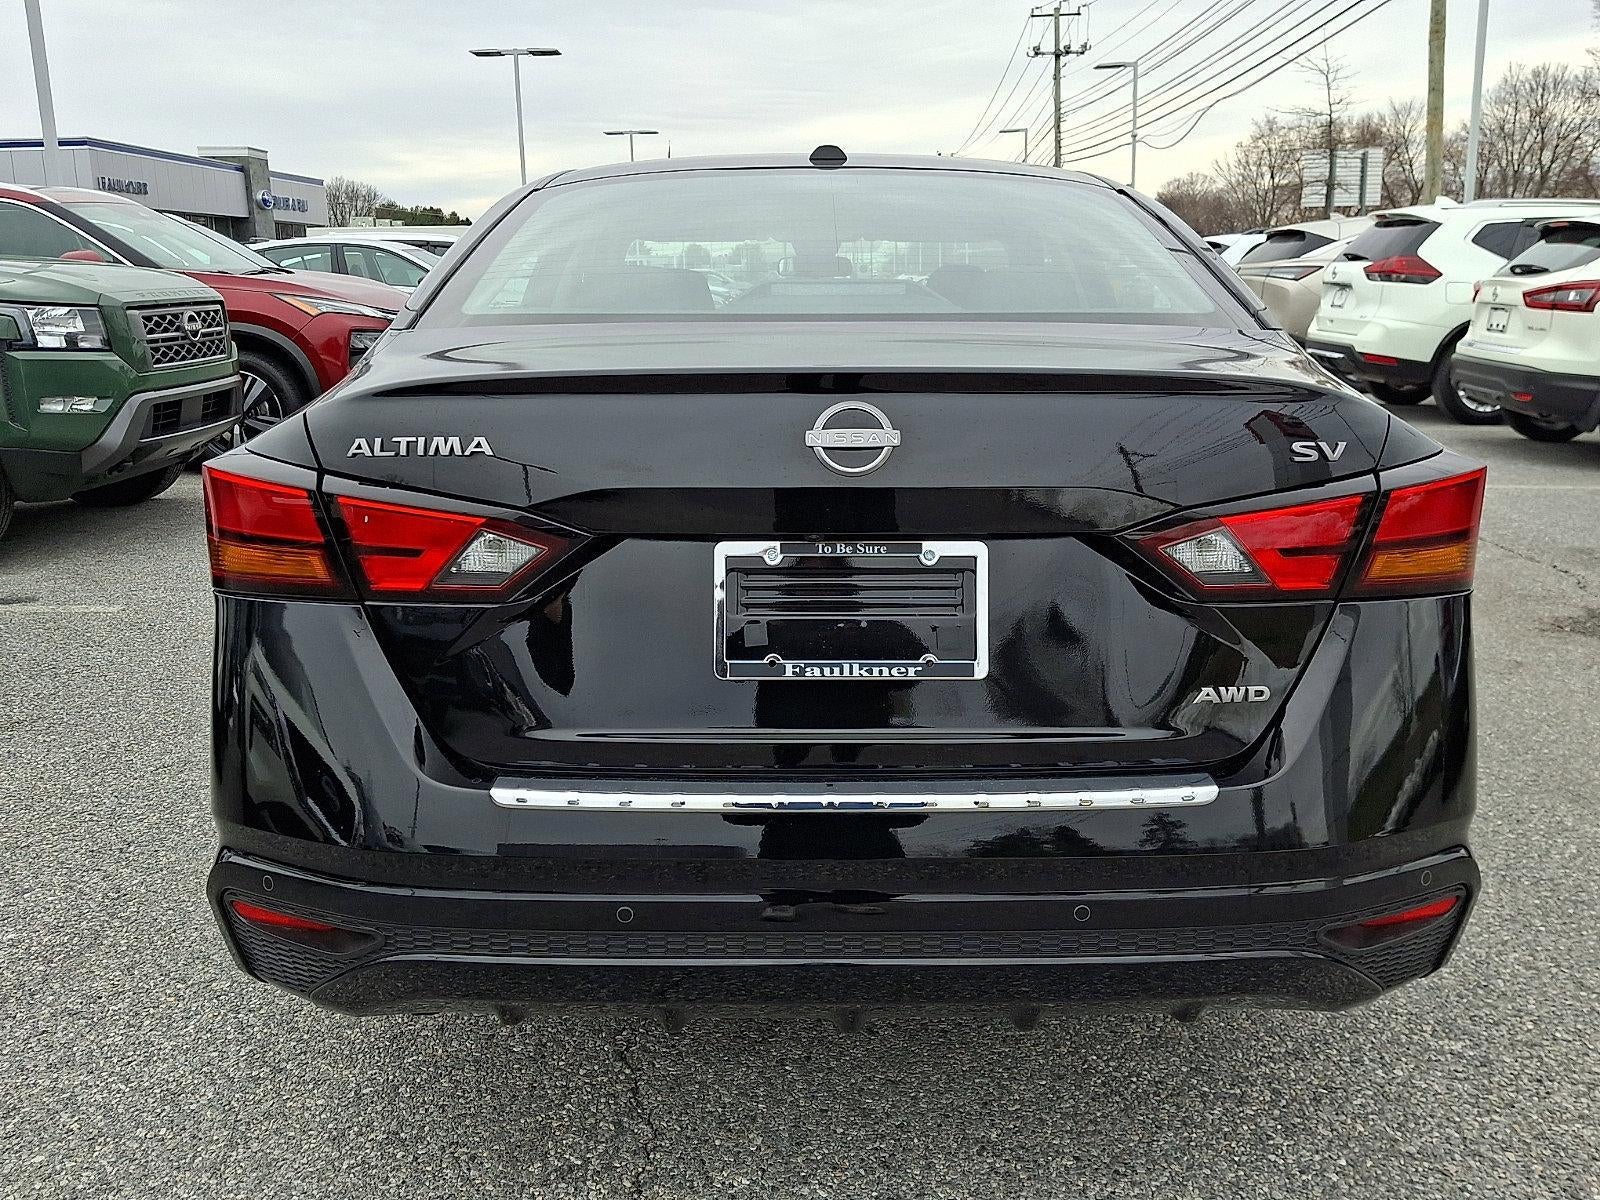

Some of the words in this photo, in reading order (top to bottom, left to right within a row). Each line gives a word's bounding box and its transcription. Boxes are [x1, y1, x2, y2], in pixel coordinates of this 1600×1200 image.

[807, 432, 898, 444] NISSAN
[346, 436, 495, 457] ALTIMA
[1290, 441, 1348, 462] SV
[815, 543, 832, 554] To
[836, 543, 853, 554] Be
[856, 543, 888, 554] Sure
[782, 663, 923, 677] Faulkner
[1192, 685, 1271, 704] AWD
